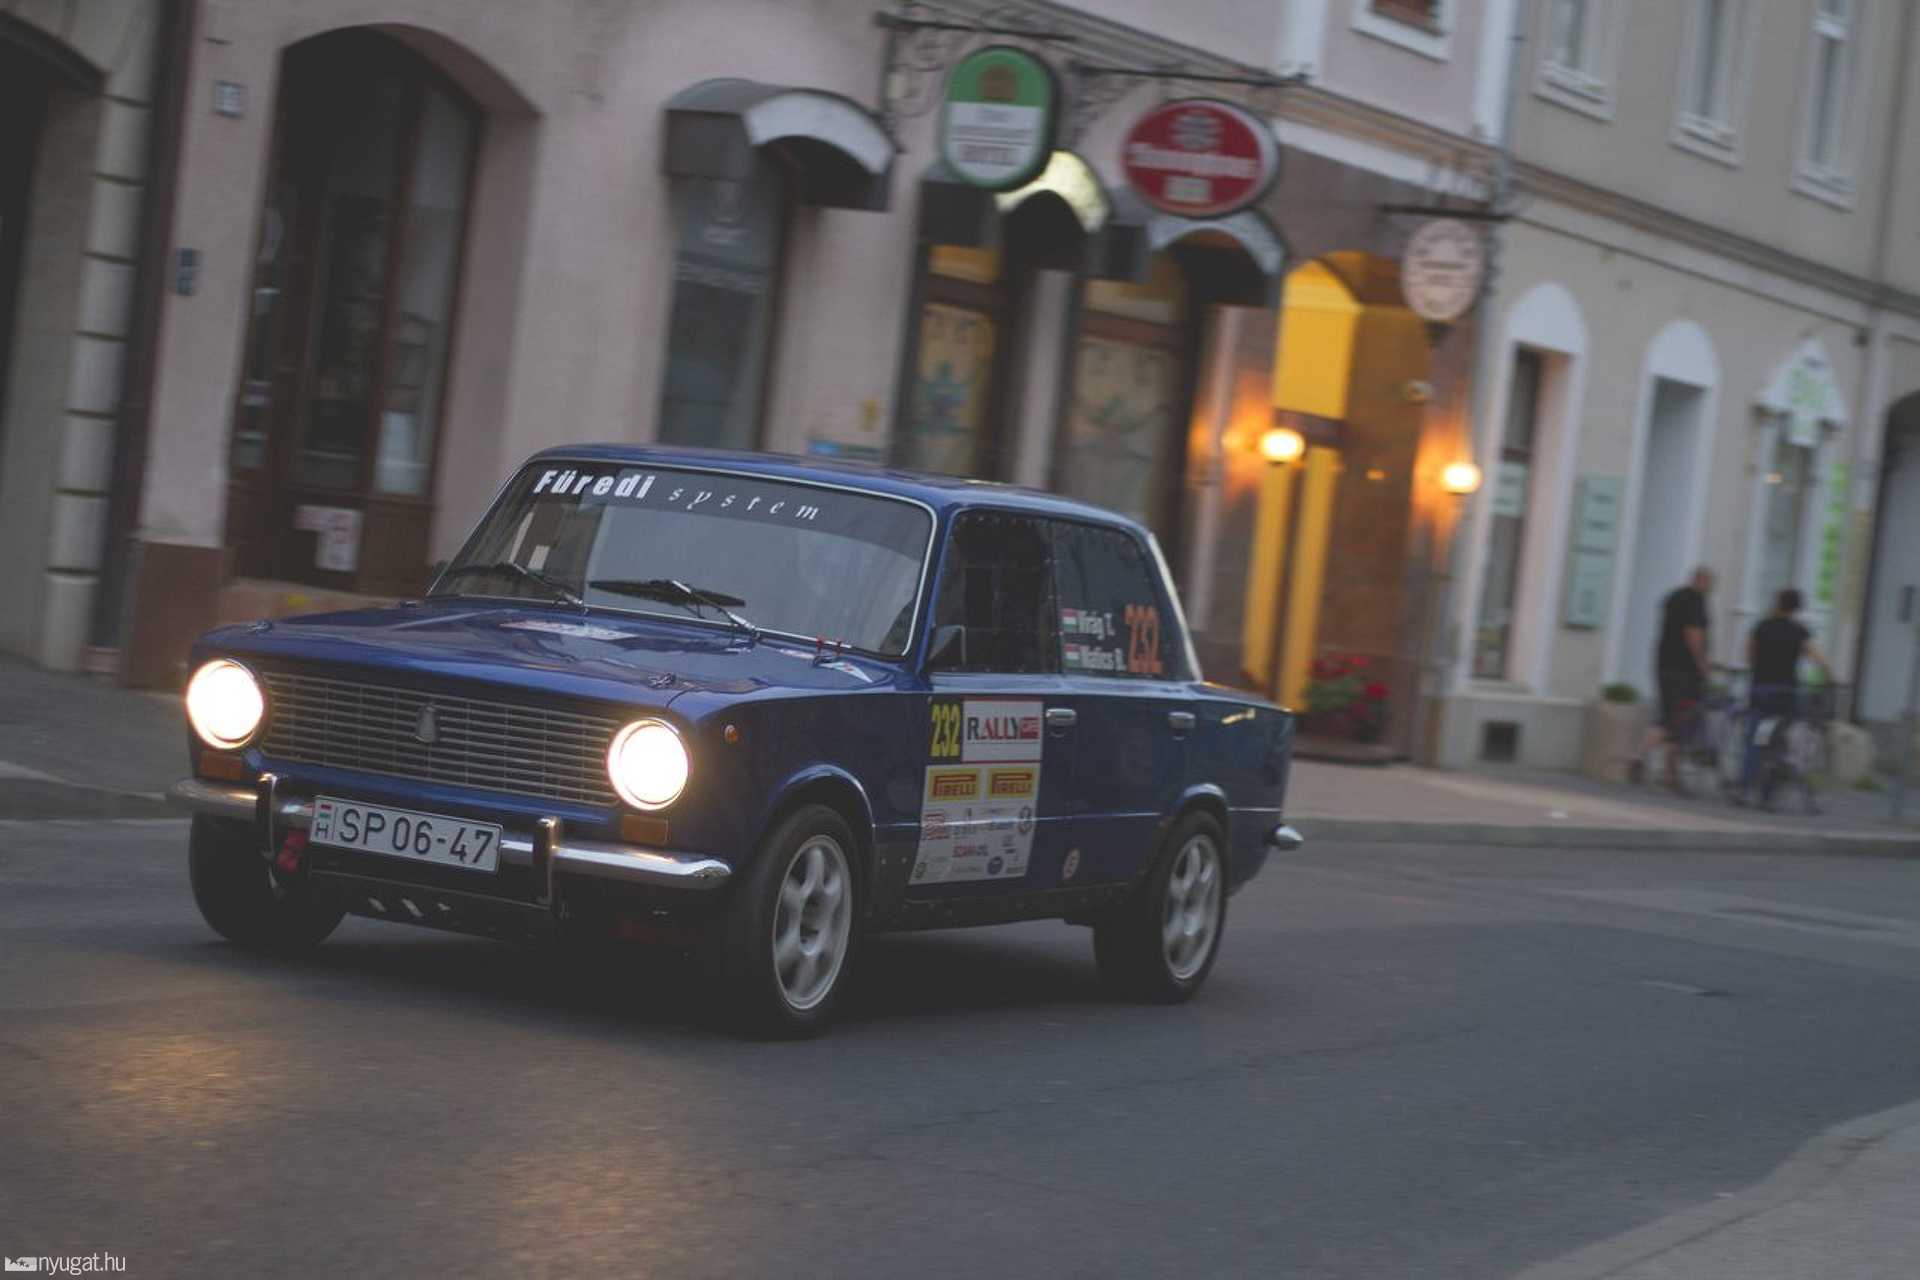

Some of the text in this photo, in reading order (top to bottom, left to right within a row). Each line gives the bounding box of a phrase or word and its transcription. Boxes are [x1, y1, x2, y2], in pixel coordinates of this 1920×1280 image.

[533, 469, 656, 499] Füredi
[1124, 606, 1162, 673] 232
[931, 703, 961, 757] 232
[966, 716, 1020, 741] RALLY
[315, 822, 330, 839] H
